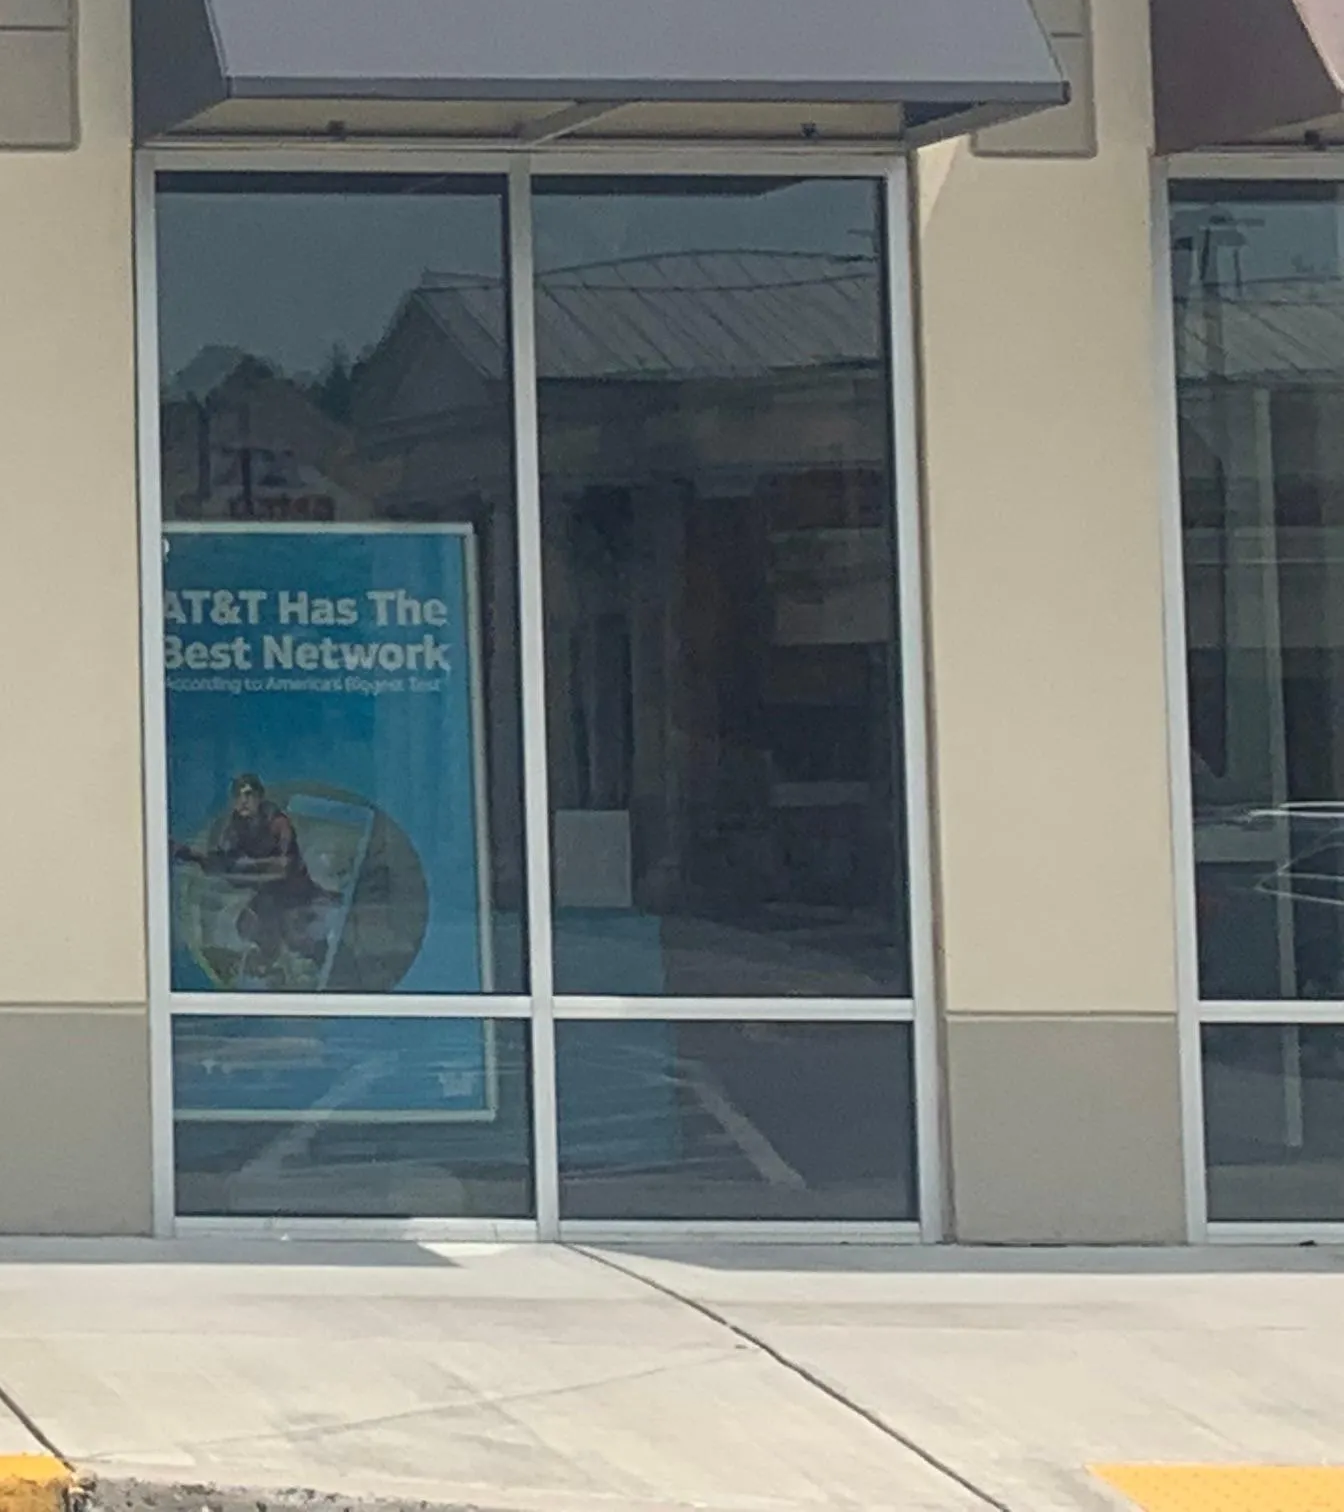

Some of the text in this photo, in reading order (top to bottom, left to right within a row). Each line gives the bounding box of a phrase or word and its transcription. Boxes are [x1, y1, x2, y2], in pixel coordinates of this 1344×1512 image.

[277, 590, 359, 626] Has
[366, 588, 450, 627] The
[164, 633, 452, 673] Best Network
